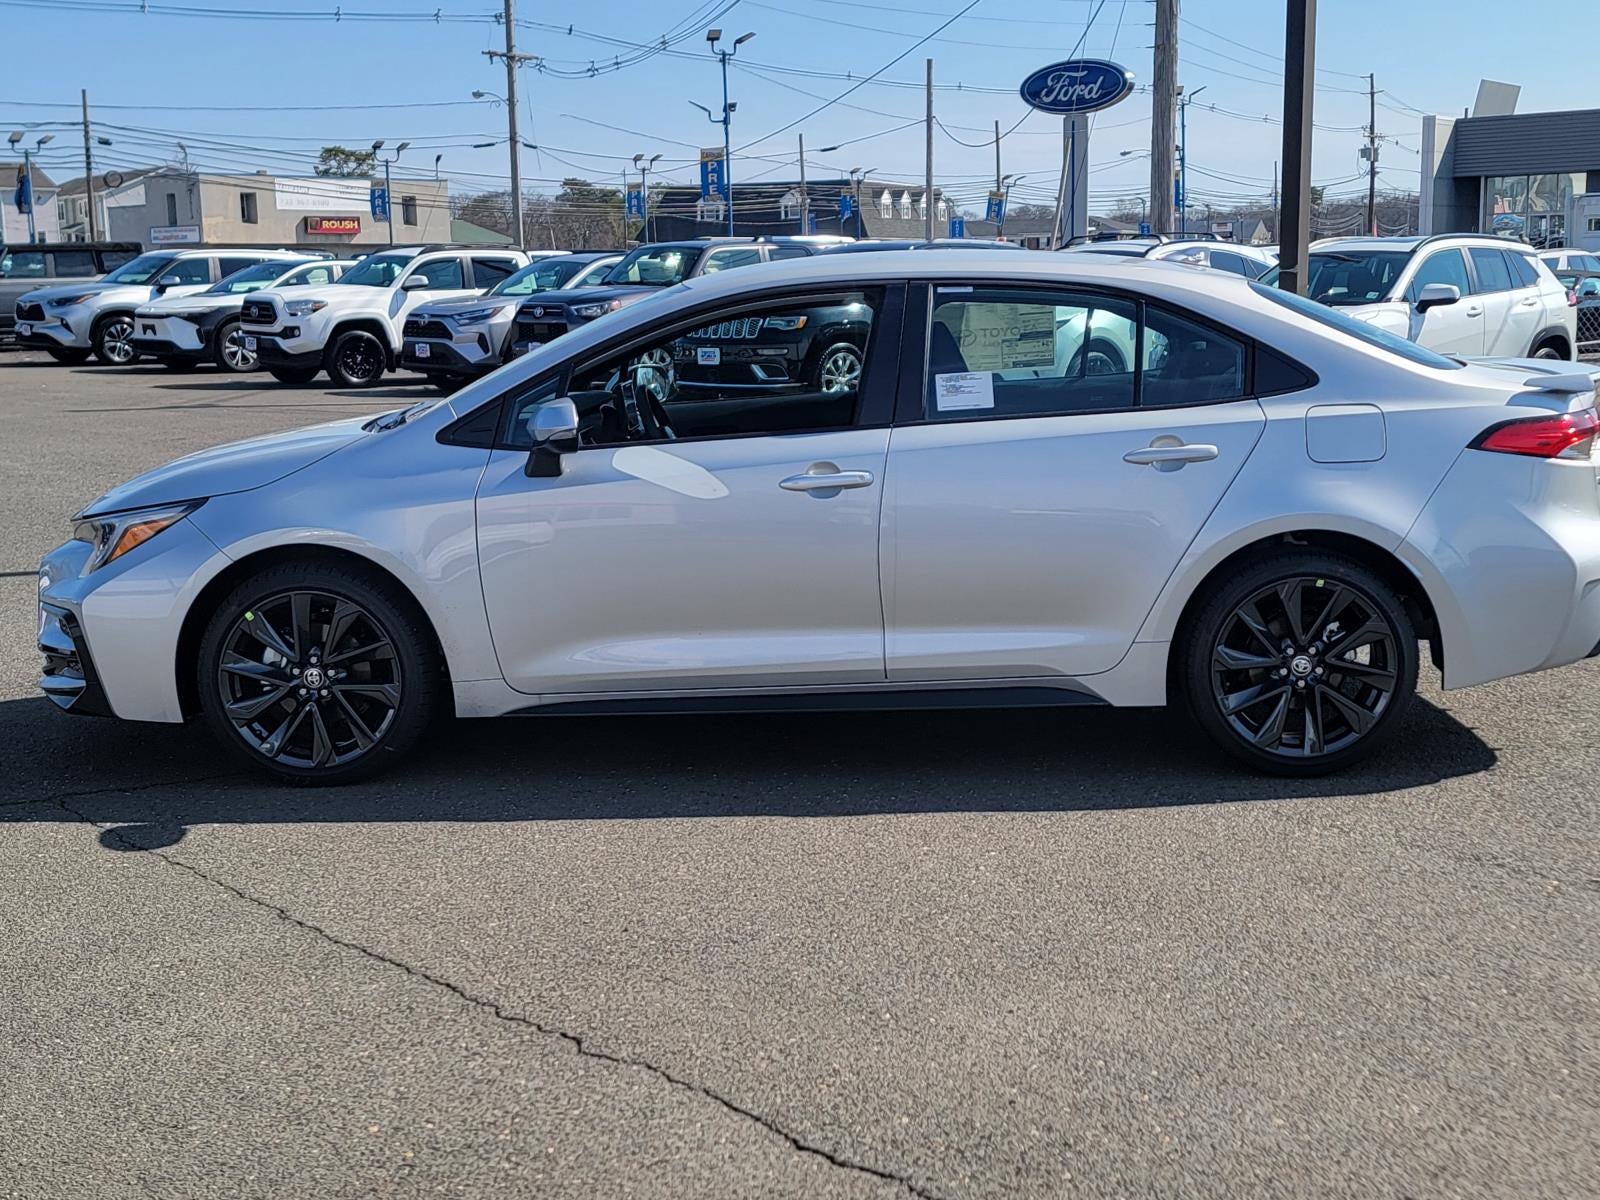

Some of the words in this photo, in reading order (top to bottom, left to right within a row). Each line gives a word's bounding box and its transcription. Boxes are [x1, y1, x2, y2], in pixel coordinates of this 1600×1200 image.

[1040, 71, 1104, 102] Ford
[708, 161, 718, 195] PRE
[322, 220, 358, 229] ROUSH
[980, 323, 1037, 338] TOYOA
